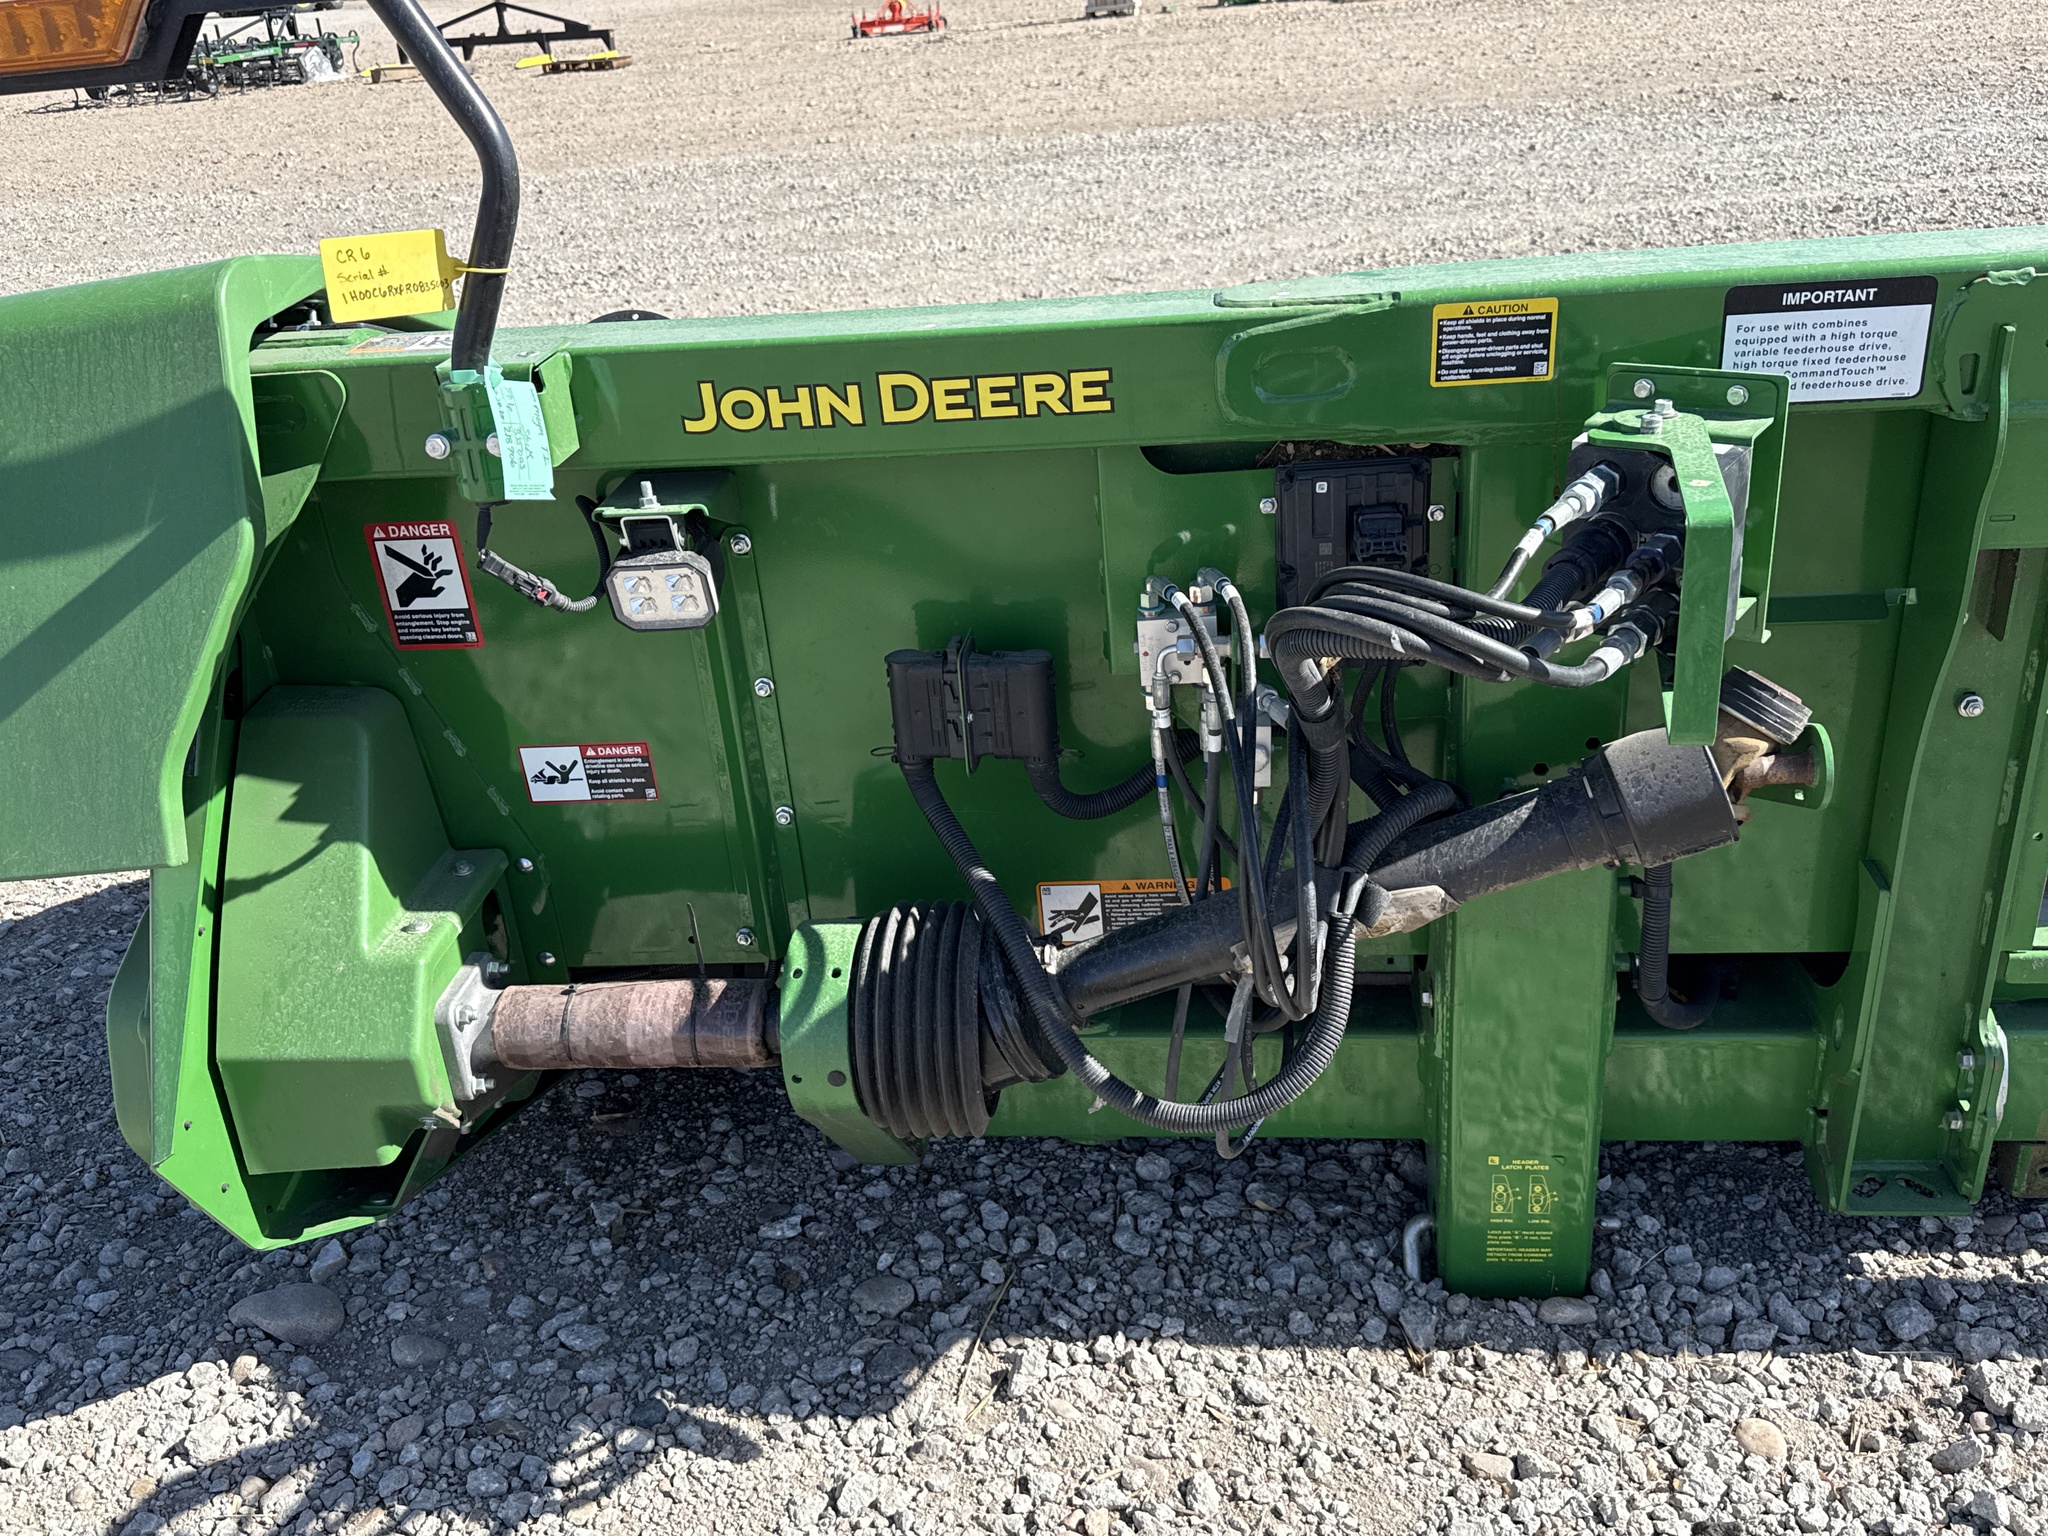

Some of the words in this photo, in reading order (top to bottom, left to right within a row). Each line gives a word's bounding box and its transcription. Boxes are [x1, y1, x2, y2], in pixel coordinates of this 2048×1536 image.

[336, 249, 357, 263] CR
[360, 248, 370, 260] 6
[337, 269, 374, 283] Serial
[378, 265, 389, 277] #
[1782, 288, 1878, 306] IMPORTANT
[1478, 303, 1528, 314] CAUTION
[1737, 324, 1755, 333] For
[1760, 323, 1779, 331] use
[1784, 322, 1807, 330] with
[1812, 319, 1868, 329] combines
[1735, 334, 1787, 346] equipped
[1792, 333, 1815, 342] with
[1831, 331, 1856, 342] high
[1860, 330, 1898, 340] torque
[1734, 347, 1779, 357] variable
[1784, 344, 1854, 354] feederhouse
[1859, 342, 1891, 351] drive,
[1733, 360, 1757, 371] high
[1762, 358, 1798, 369] torque
[1803, 357, 1830, 366] fixed
[1835, 353, 1906, 363] feederhouse
[1801, 380, 1872, 389] feederhouse
[1876, 377, 1908, 386] drive.
[681, 379, 866, 434] JOHN
[876, 367, 1115, 425] DEERE
[388, 524, 450, 537] DANGER
[598, 746, 642, 755] DANGER
